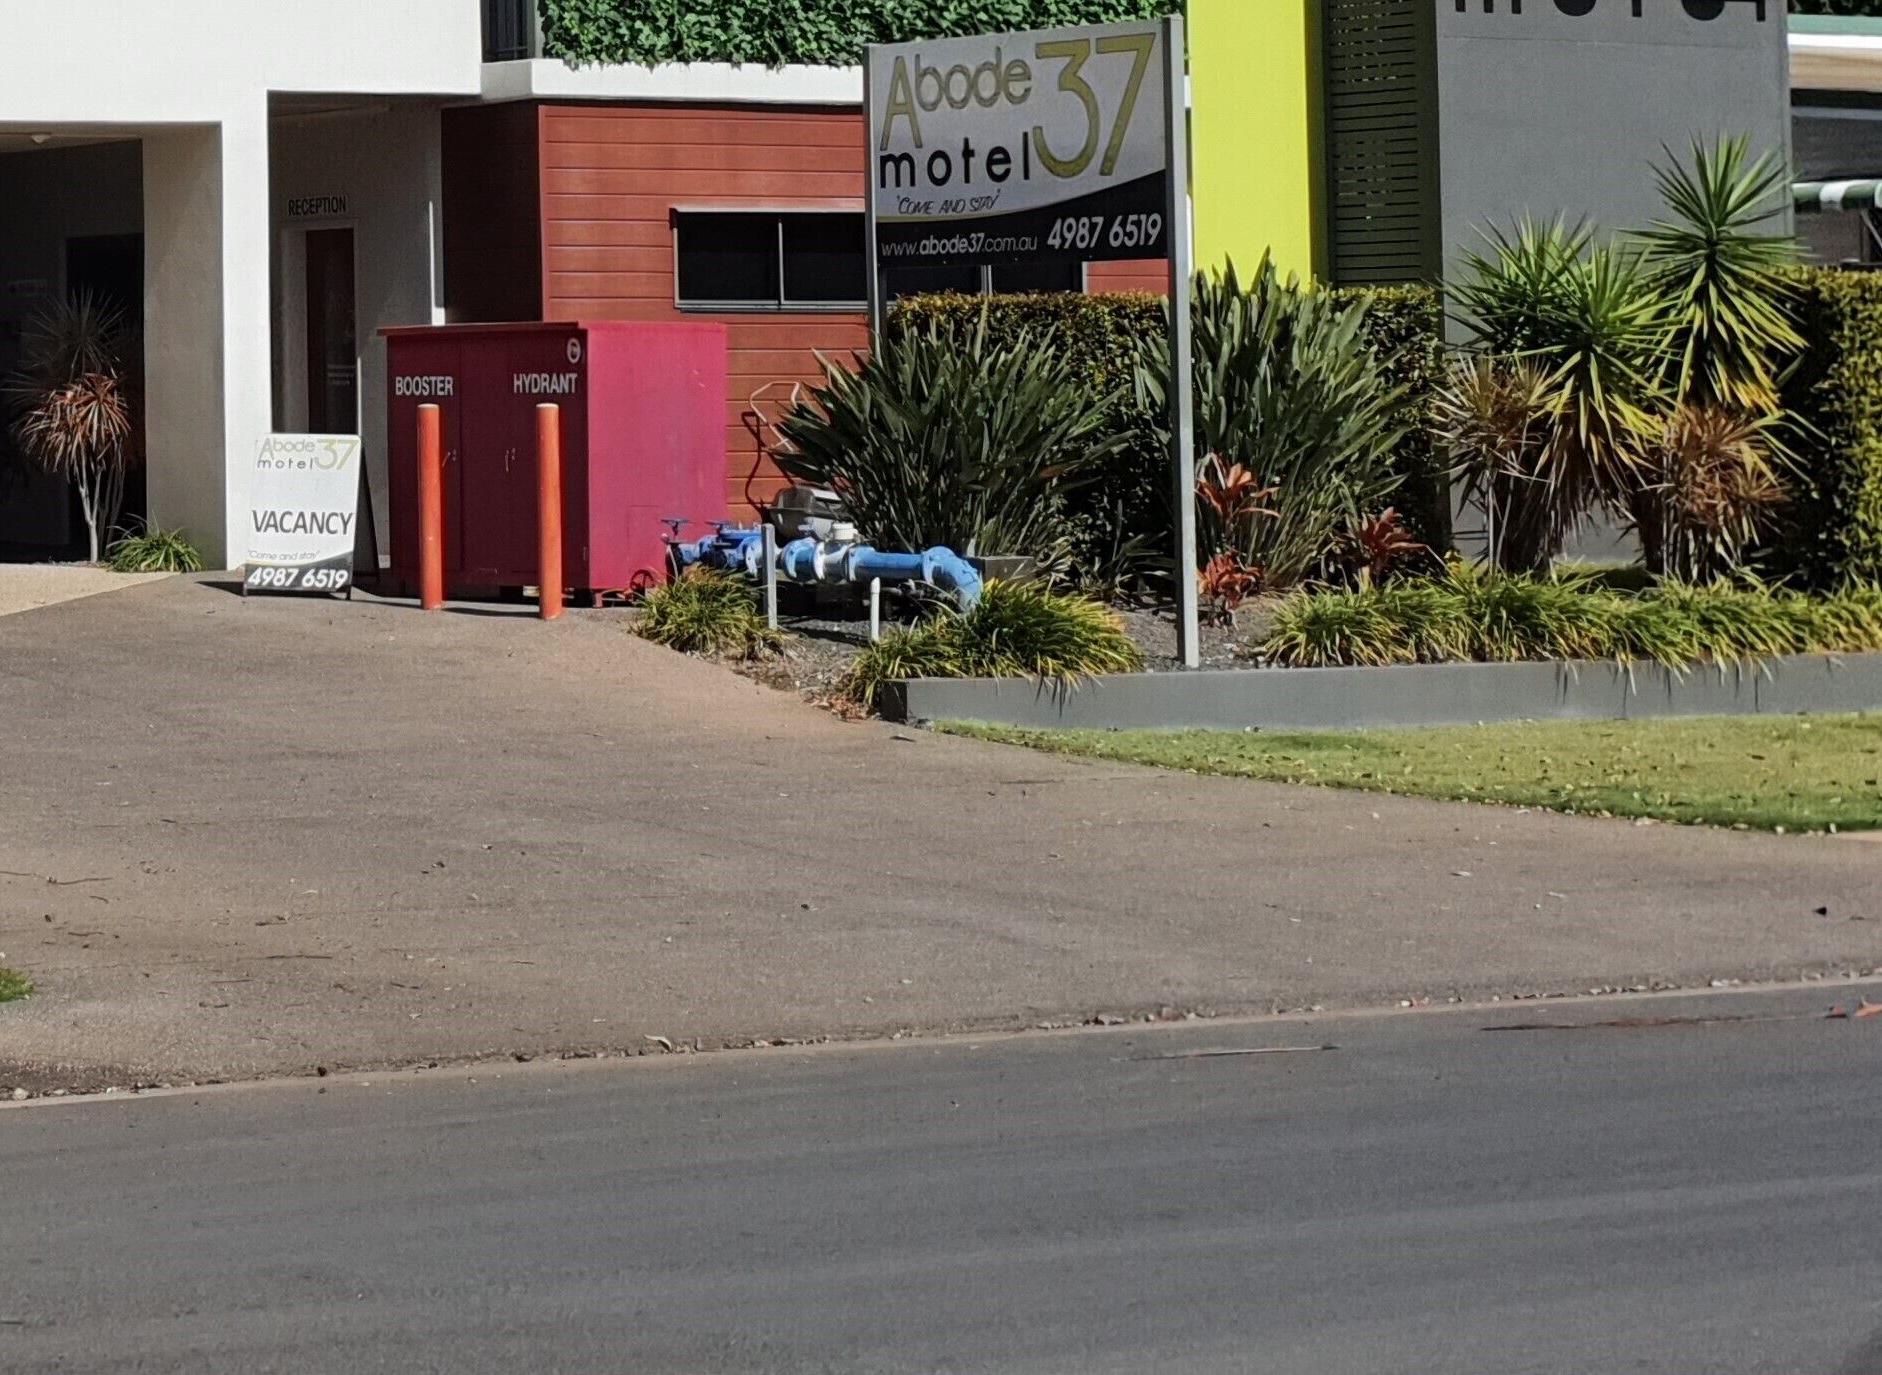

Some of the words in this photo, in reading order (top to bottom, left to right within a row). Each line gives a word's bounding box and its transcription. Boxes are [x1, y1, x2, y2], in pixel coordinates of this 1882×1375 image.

[879, 45, 1033, 152] Abode
[1031, 31, 1157, 180] 37
[879, 131, 1031, 189] motel
[287, 196, 347, 217] RECEPTION
[938, 198, 967, 214] AND
[1046, 217, 1105, 250] 4987
[1108, 213, 1163, 248] 6519
[881, 232, 1038, 257] www.abode37.com.au
[395, 376, 454, 397] BOOSTER
[513, 373, 578, 395] HYDRANT
[256, 457, 314, 470] motel
[257, 438, 316, 461] Abode
[314, 439, 360, 471] 37
[252, 510, 354, 536] VACANCY
[279, 552, 299, 560] and
[246, 567, 299, 587] 4987
[301, 569, 349, 589] 6519
